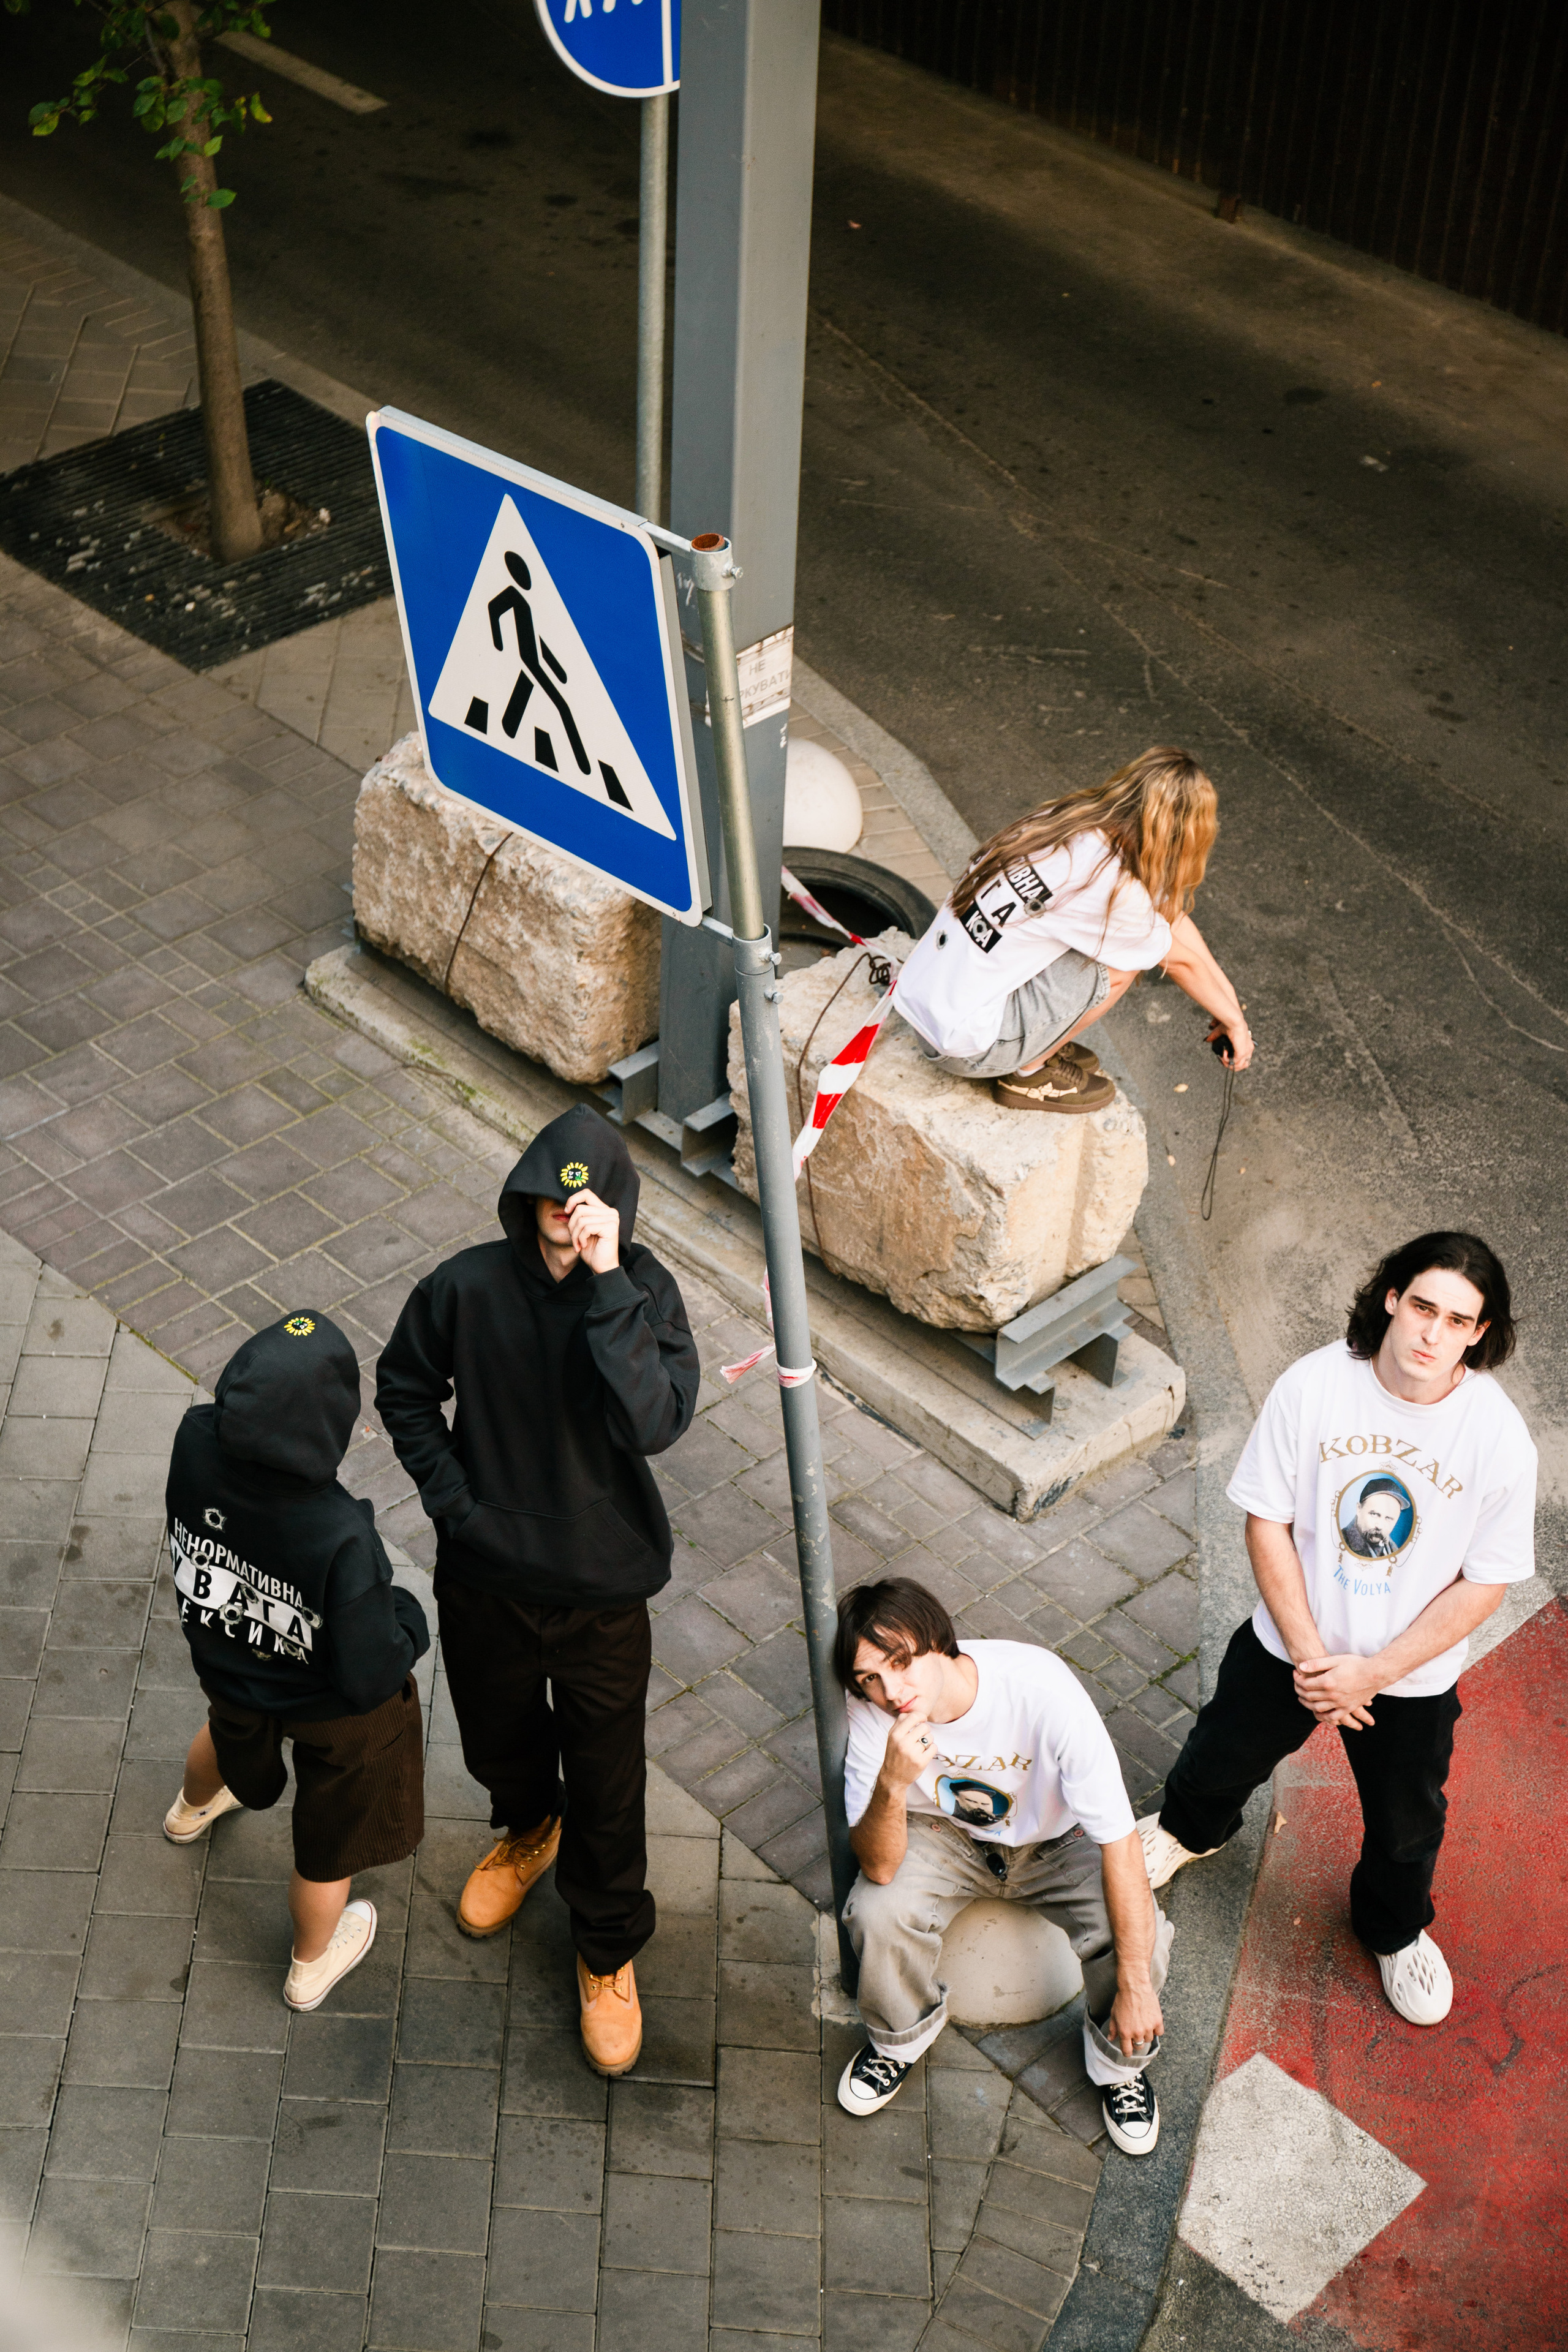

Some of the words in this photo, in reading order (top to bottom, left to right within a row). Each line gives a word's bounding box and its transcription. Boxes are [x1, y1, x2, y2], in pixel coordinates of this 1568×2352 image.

[740, 669, 790, 698] РКУВАТ
[749, 659, 766, 676] НЕ
[1320, 1434, 1463, 1499] KOBZAR
[175, 1517, 303, 1608] НЕНОРМАТИВНА
[182, 1598, 309, 1664] ЕКСИКА
[933, 1752, 1032, 1771] BZAR
